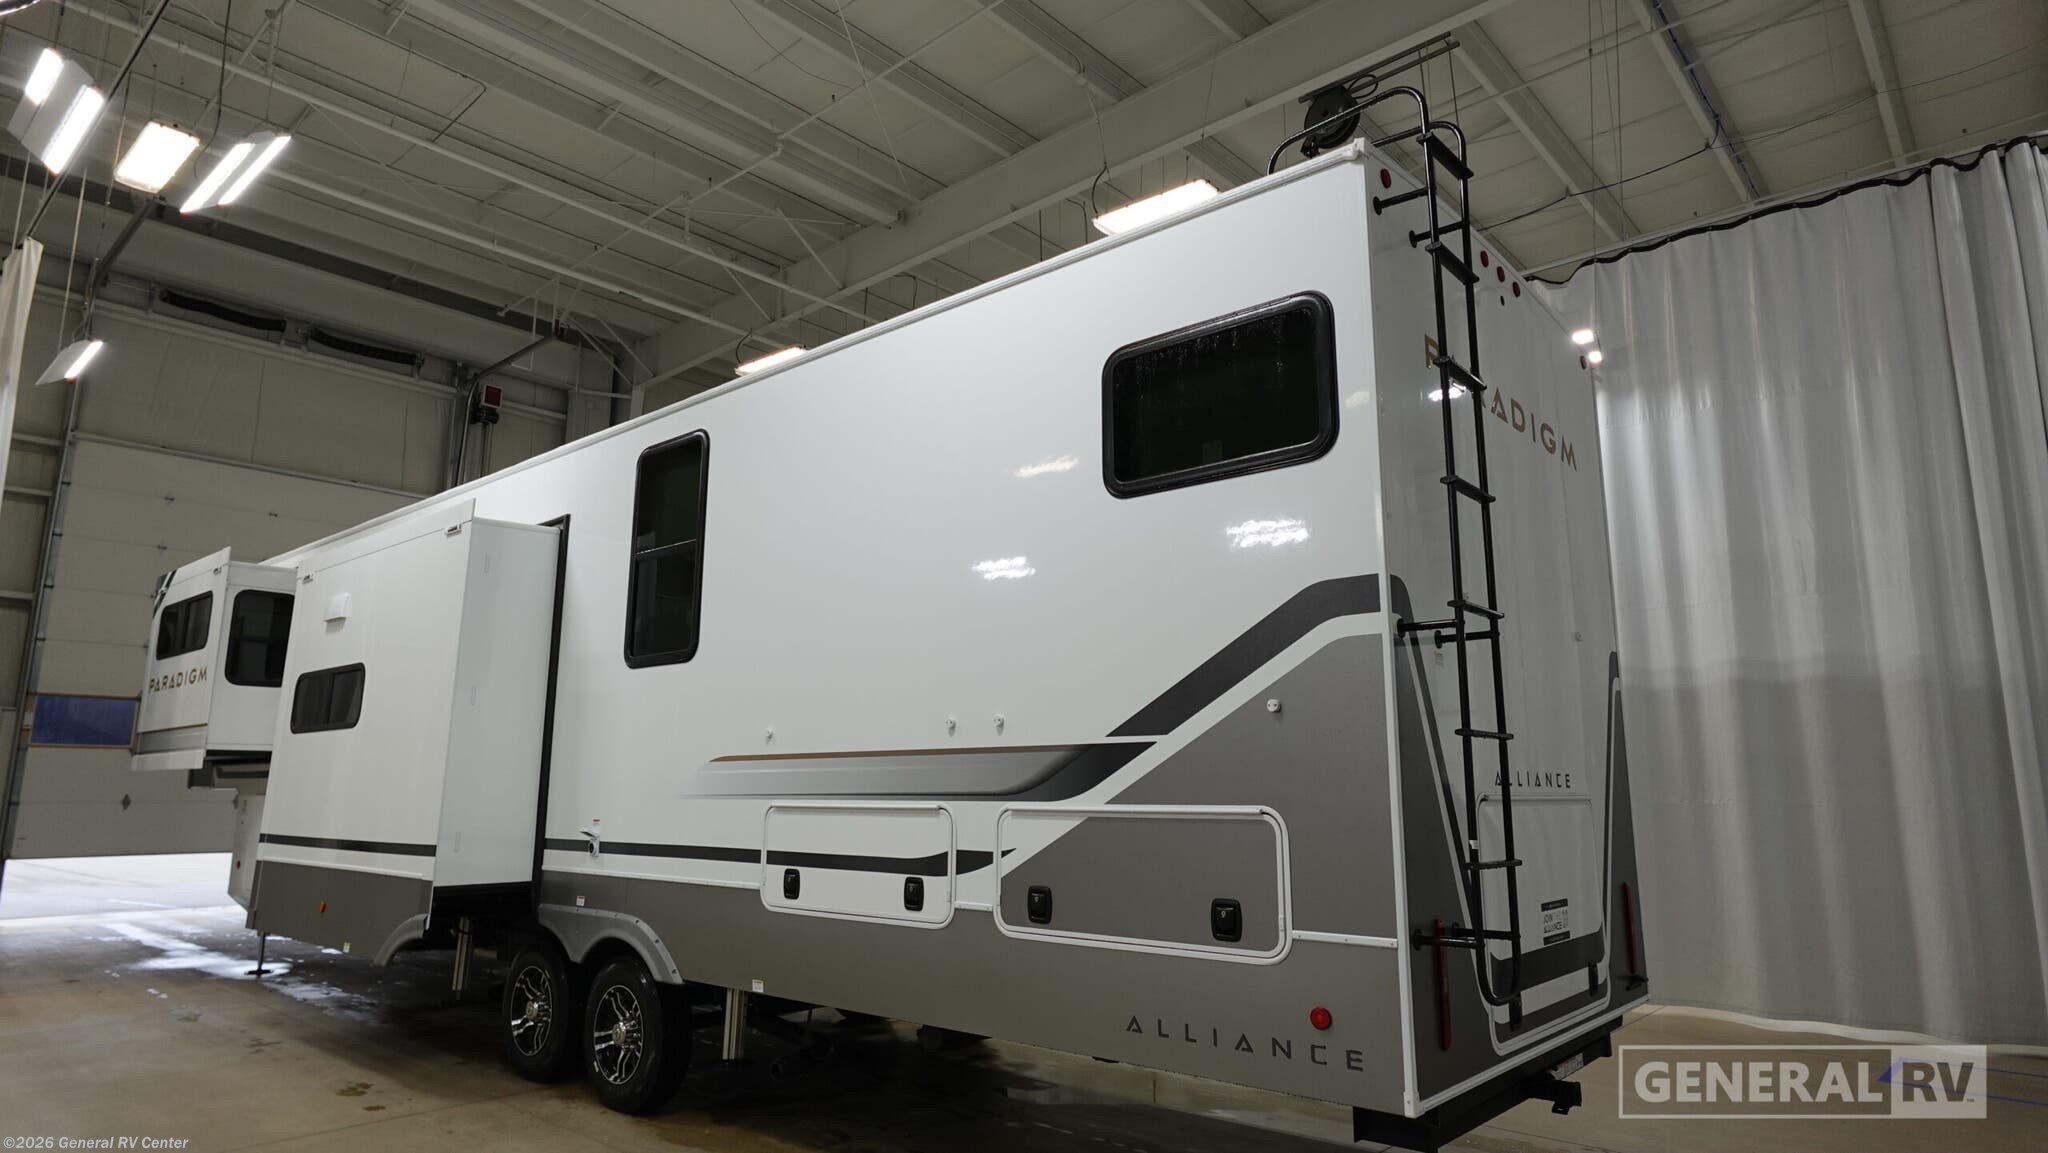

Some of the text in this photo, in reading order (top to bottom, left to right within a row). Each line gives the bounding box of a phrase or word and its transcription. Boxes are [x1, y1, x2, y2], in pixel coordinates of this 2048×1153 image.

[1424, 334, 1577, 471] PADIGM
[148, 666, 208, 693] PARADIGM
[1494, 770, 1571, 788] ALIANCE
[1126, 1015, 1364, 1072] ALLIANCE
